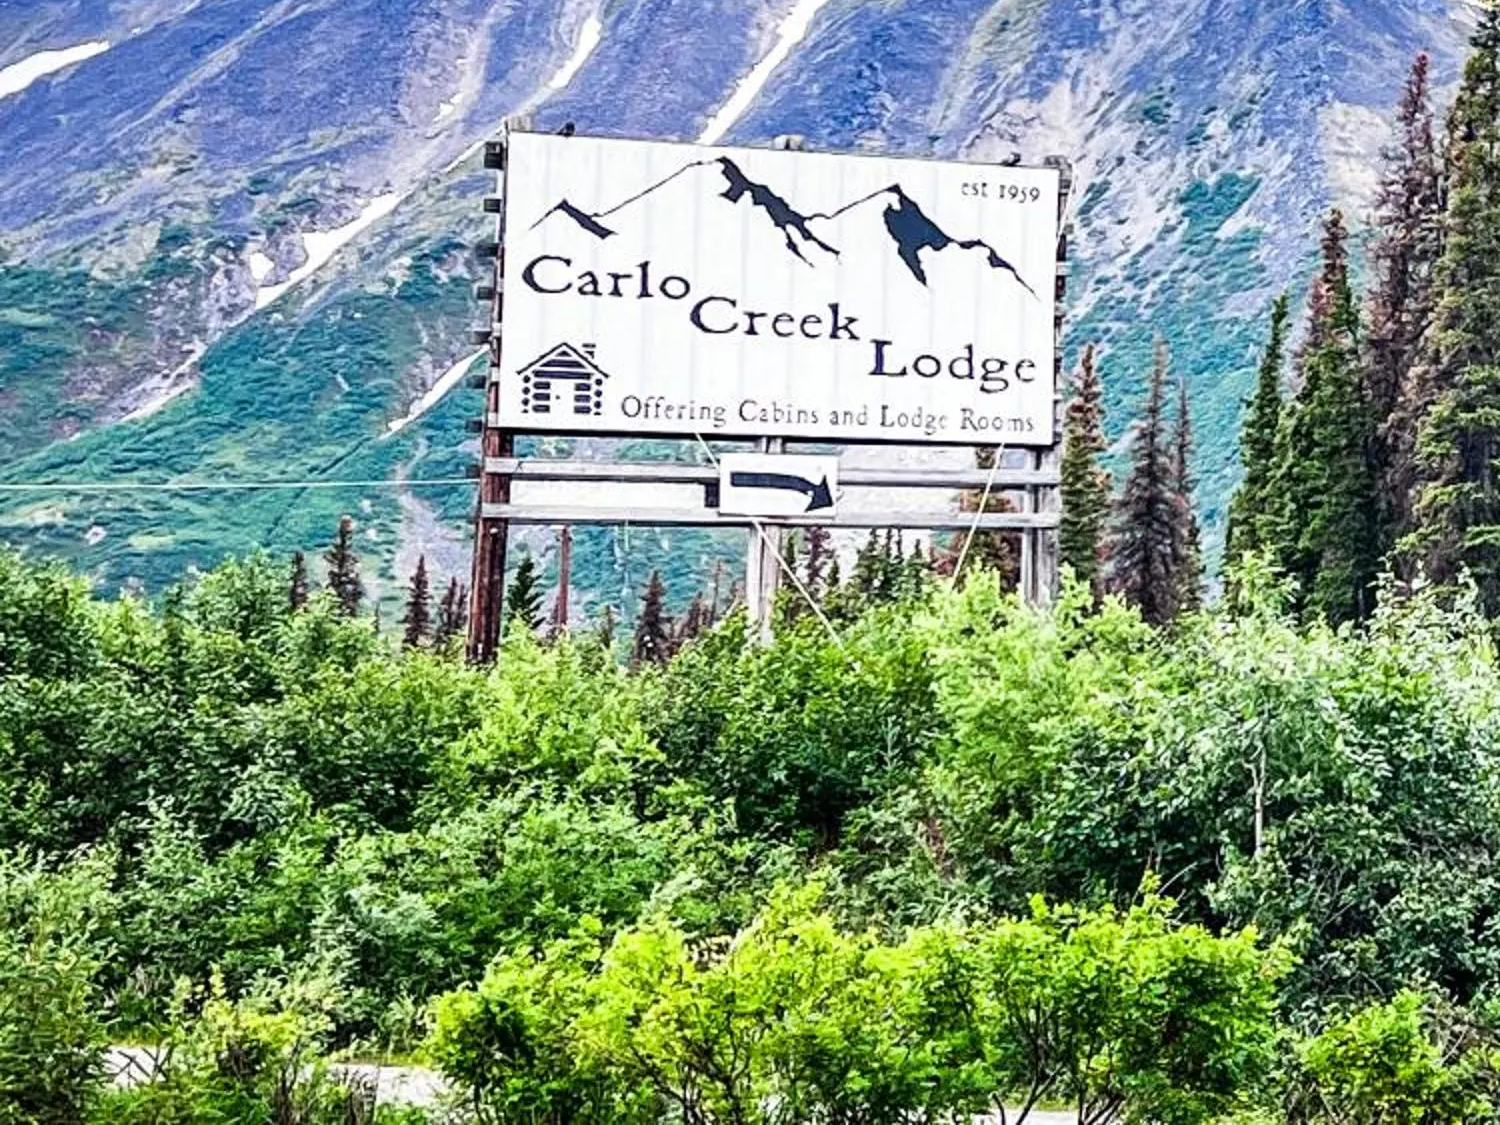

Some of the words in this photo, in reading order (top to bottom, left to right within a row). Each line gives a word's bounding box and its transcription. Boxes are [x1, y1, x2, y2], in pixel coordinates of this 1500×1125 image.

[960, 180, 989, 200] est
[999, 184, 1041, 203] 1959
[521, 254, 691, 301] Carlo
[690, 296, 860, 341] Creek
[869, 339, 1037, 394] Lodge
[620, 395, 727, 427] Offering
[738, 399, 819, 426] Cabins
[829, 405, 869, 426] and
[880, 404, 949, 436] Lodge
[960, 407, 1035, 433] Rooms
